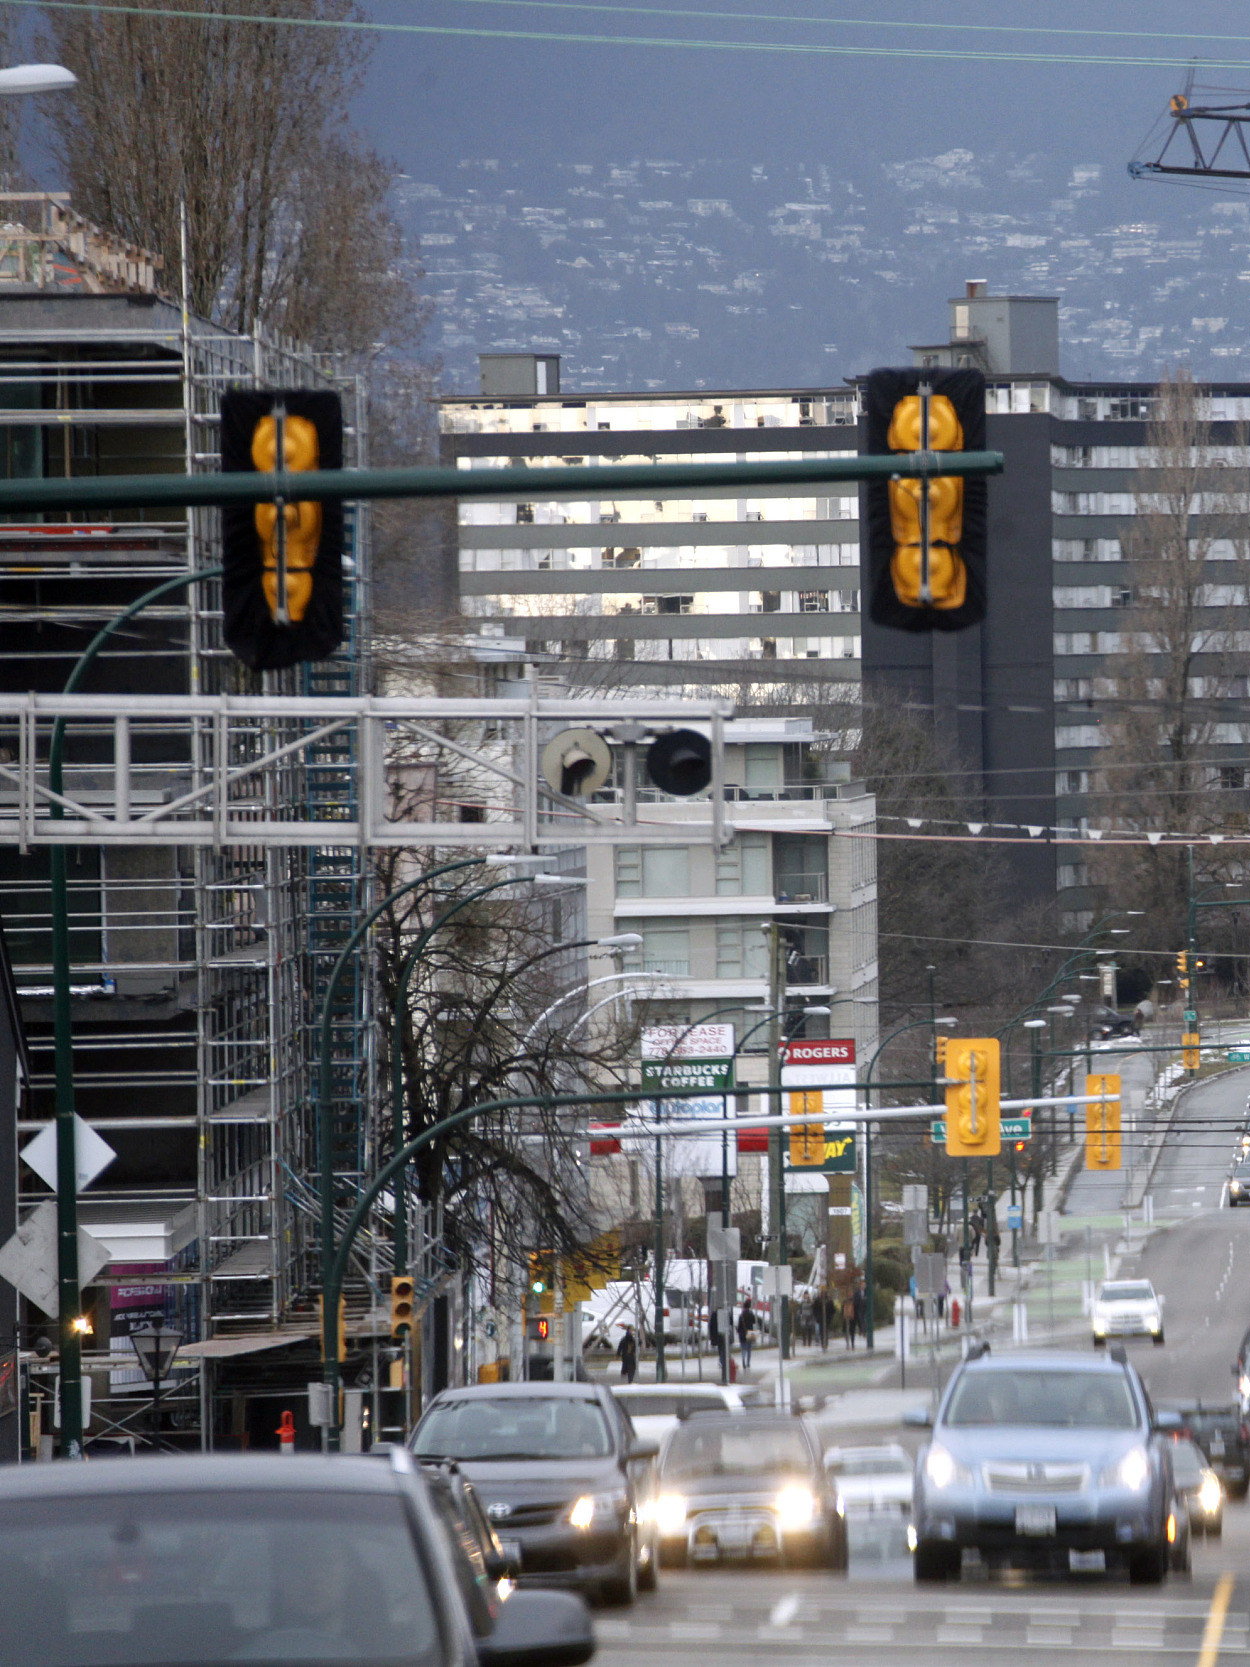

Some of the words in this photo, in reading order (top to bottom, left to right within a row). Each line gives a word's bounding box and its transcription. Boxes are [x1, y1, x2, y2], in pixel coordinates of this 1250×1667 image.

[649, 1028, 677, 1037] FOR
[681, 1026, 726, 1037] LEASE
[792, 1047, 848, 1058] ROGERS
[645, 1064, 728, 1077] STARBUCKS
[661, 1076, 715, 1088] COFFEE
[999, 1122, 1023, 1136] Ave
